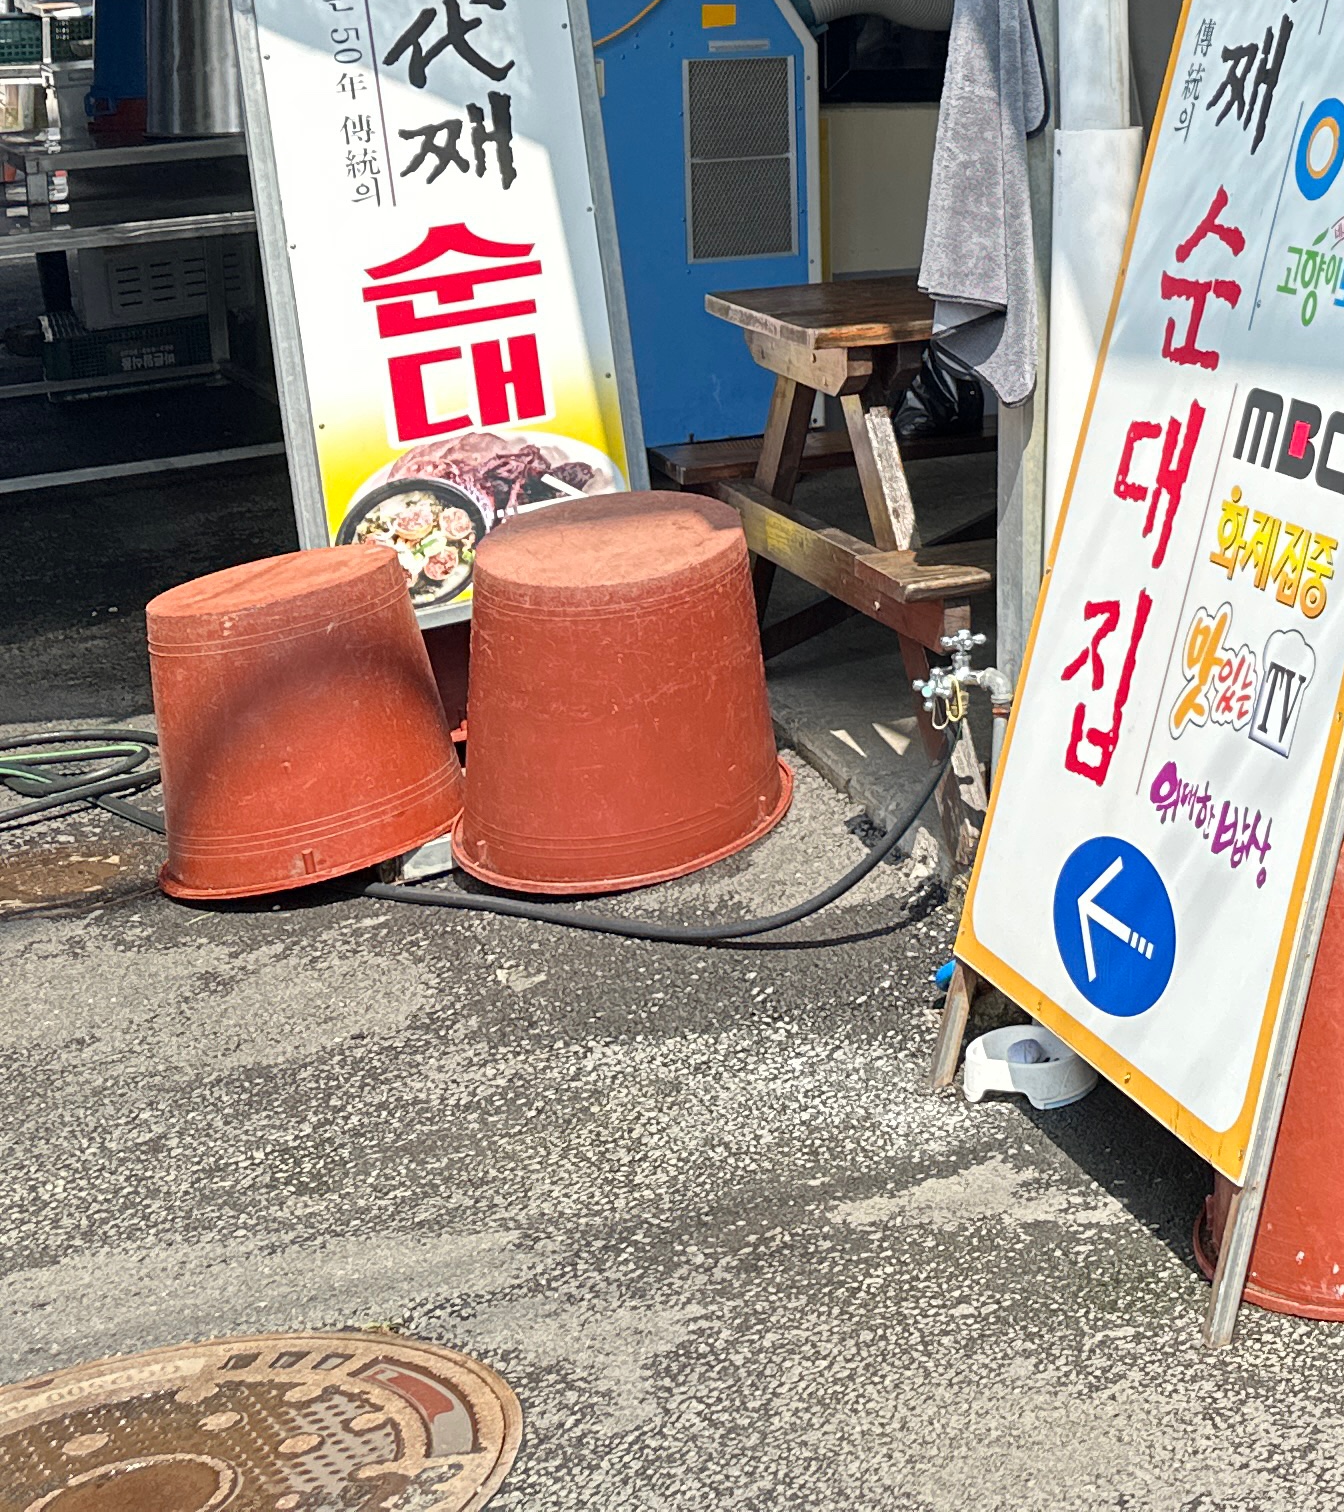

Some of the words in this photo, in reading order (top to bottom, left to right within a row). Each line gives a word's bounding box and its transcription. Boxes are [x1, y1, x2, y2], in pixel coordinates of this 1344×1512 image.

[362, 221, 547, 441] 순대
[1276, 245, 1343, 327] 고향이
[1060, 185, 1246, 787] 순대집
[1209, 485, 1339, 619] 화제집중
[1172, 610, 1254, 730] 맛있는
[1257, 660, 1307, 744] TV
[1150, 760, 1216, 840] 위대한
[1211, 799, 1274, 889] 밥상
